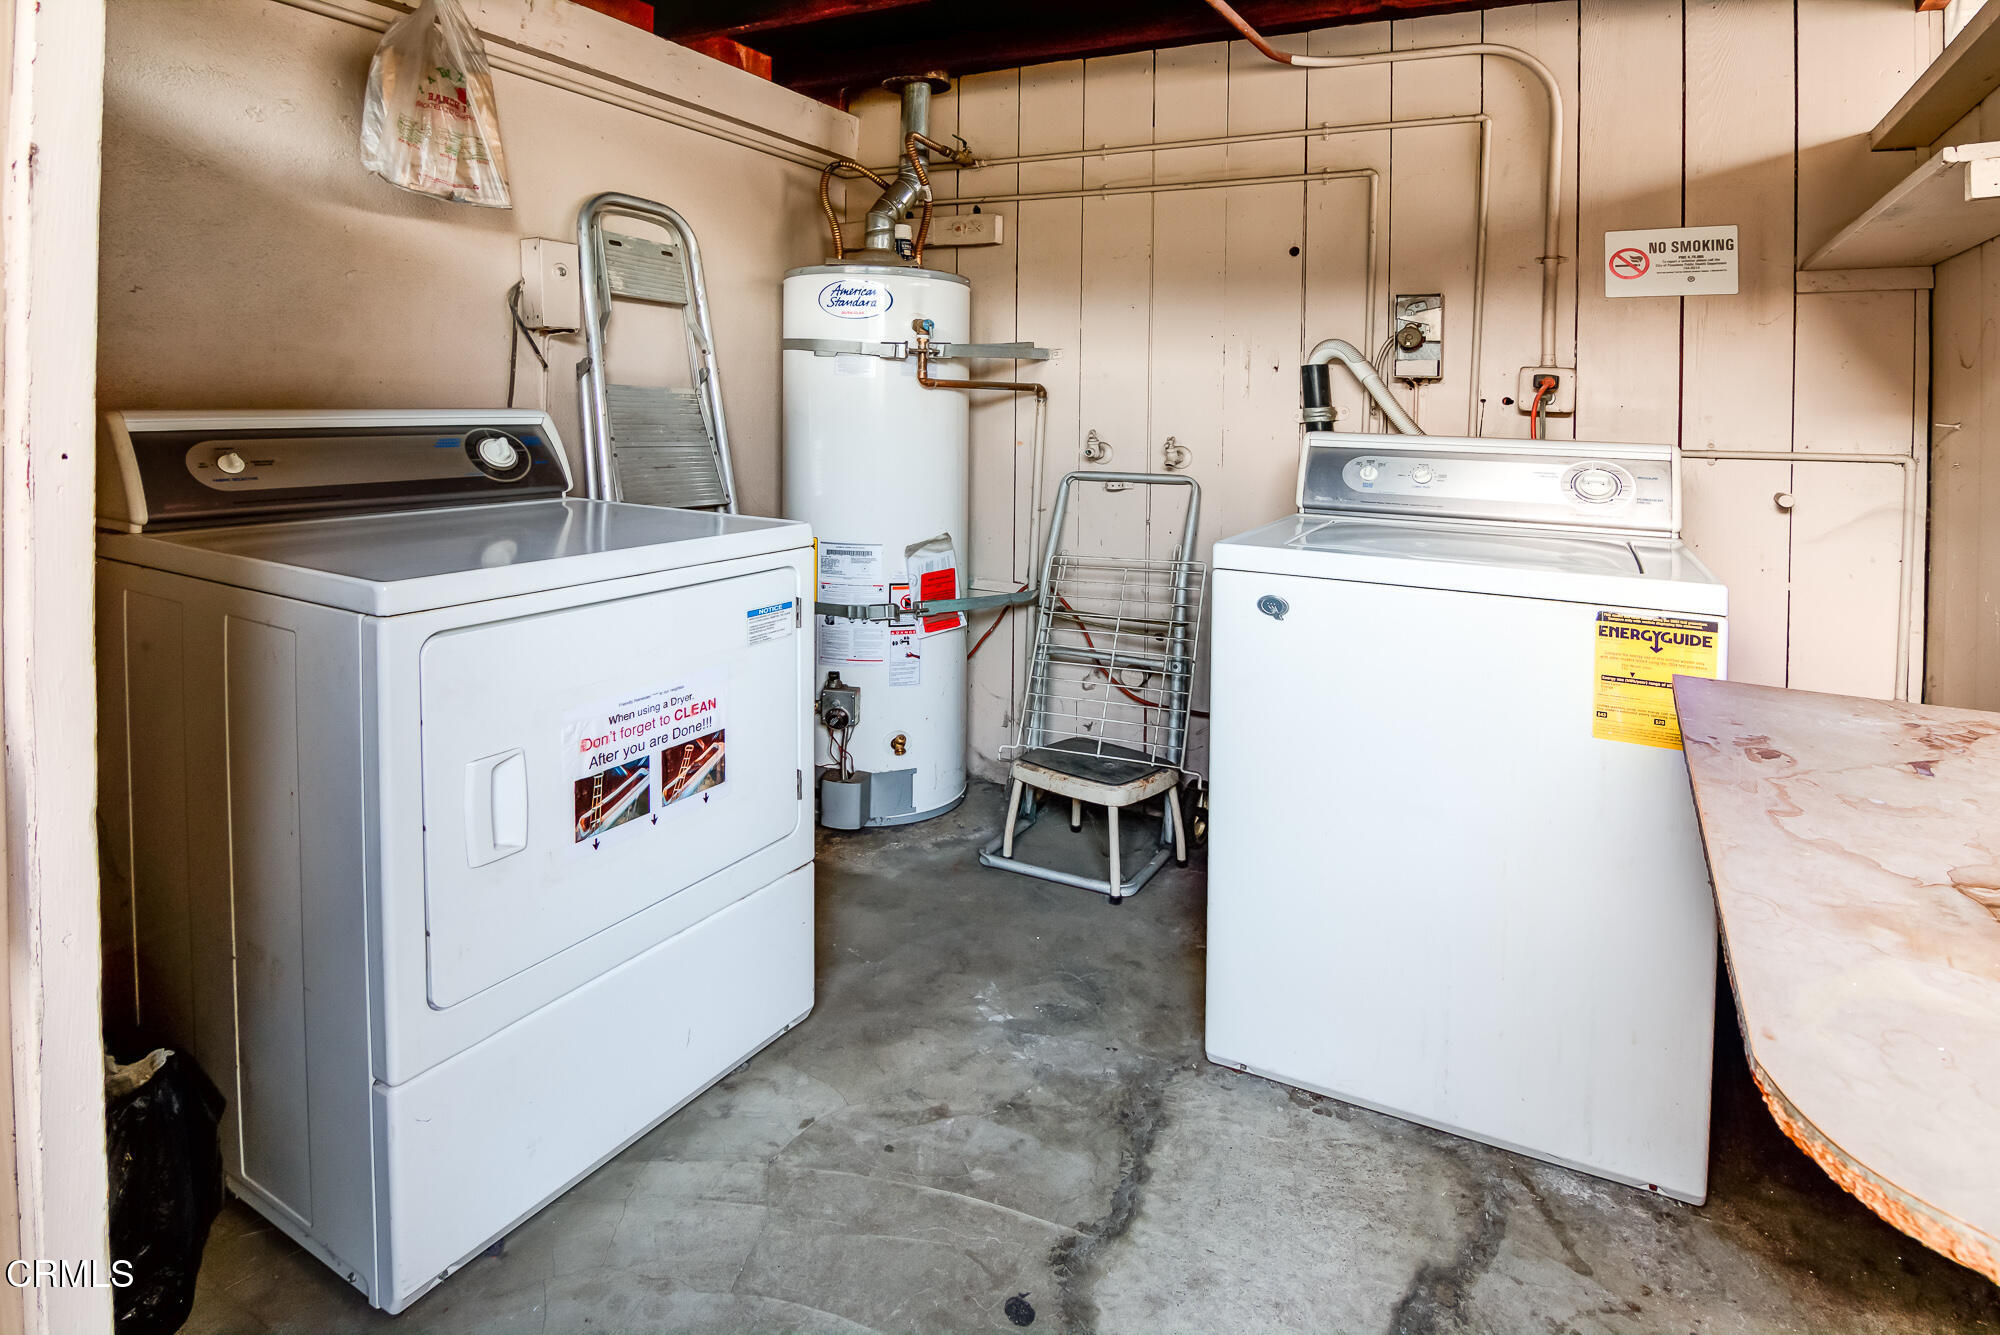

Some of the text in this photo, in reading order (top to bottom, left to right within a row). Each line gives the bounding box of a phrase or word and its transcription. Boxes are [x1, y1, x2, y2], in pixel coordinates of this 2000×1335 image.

[1649, 238, 1734, 254] NO SMOKING
[1599, 625, 1713, 650] ENERGYGUIDE
[579, 697, 717, 753] Don't forget to CLEAN
[608, 710, 635, 725] When
[638, 702, 660, 717] using
[671, 692, 695, 707] Dryer.
[589, 716, 712, 769] After you are Done!!!
